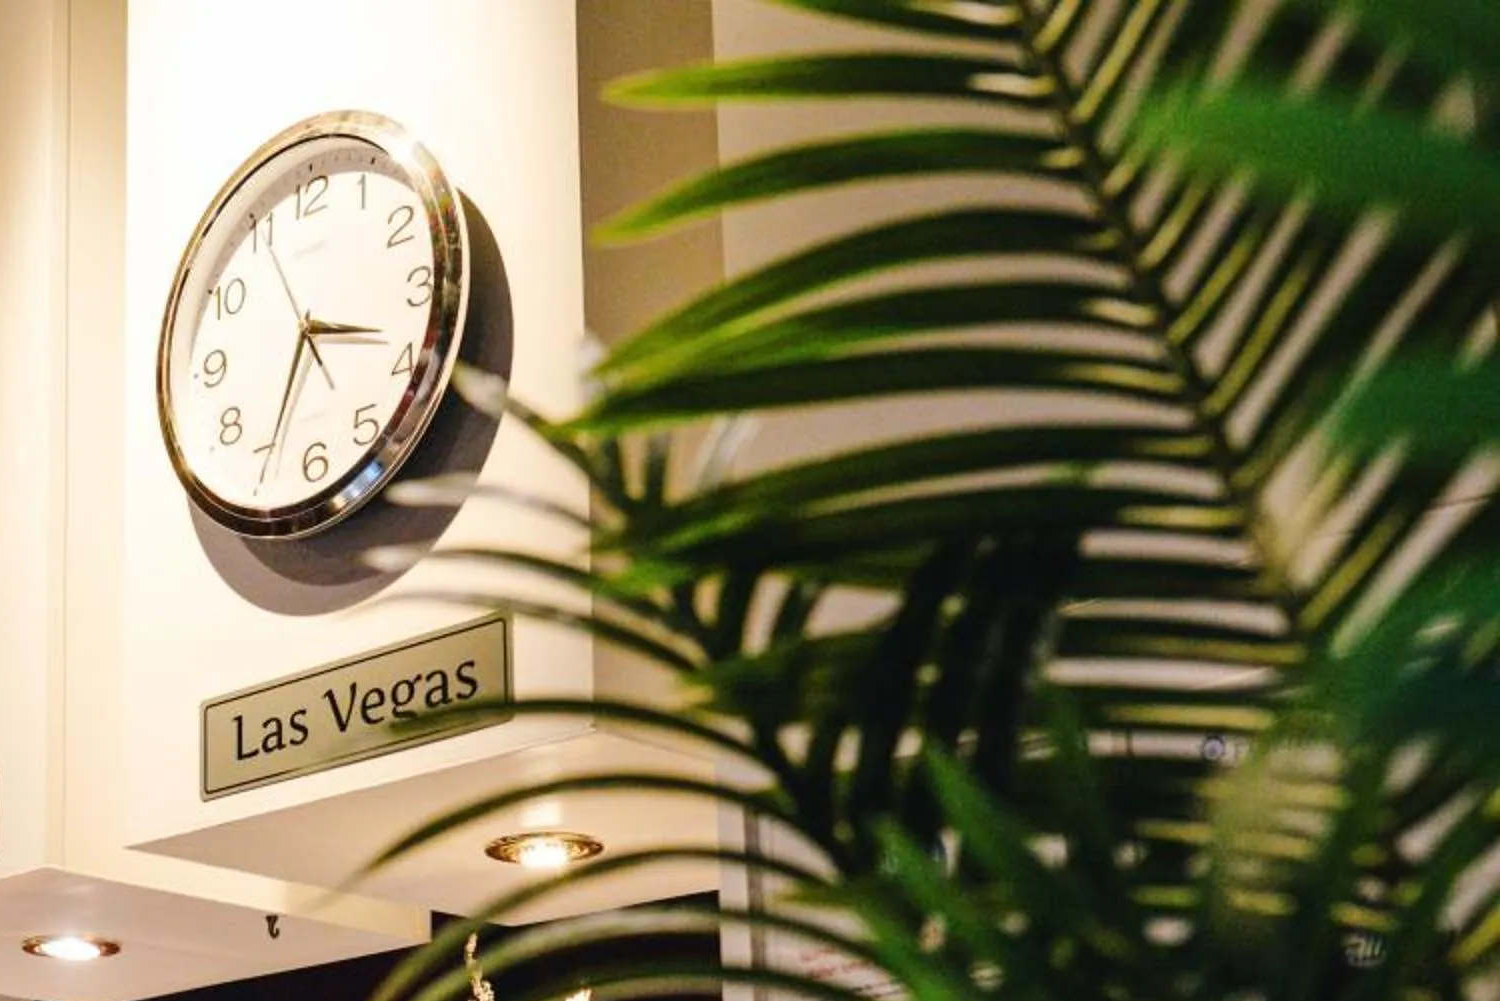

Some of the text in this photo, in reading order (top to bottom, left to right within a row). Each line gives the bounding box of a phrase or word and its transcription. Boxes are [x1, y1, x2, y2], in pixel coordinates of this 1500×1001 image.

[294, 175, 330, 220] 12
[357, 172, 368, 210] 1
[249, 212, 275, 254] 11
[386, 205, 415, 249] 2
[214, 277, 247, 321] 10
[406, 265, 434, 308] 3
[202, 348, 228, 389] 9
[391, 340, 414, 378] 4
[218, 406, 244, 447] 8
[352, 403, 380, 447] 5
[301, 442, 330, 483] 6
[232, 659, 479, 761] Las Vegas
